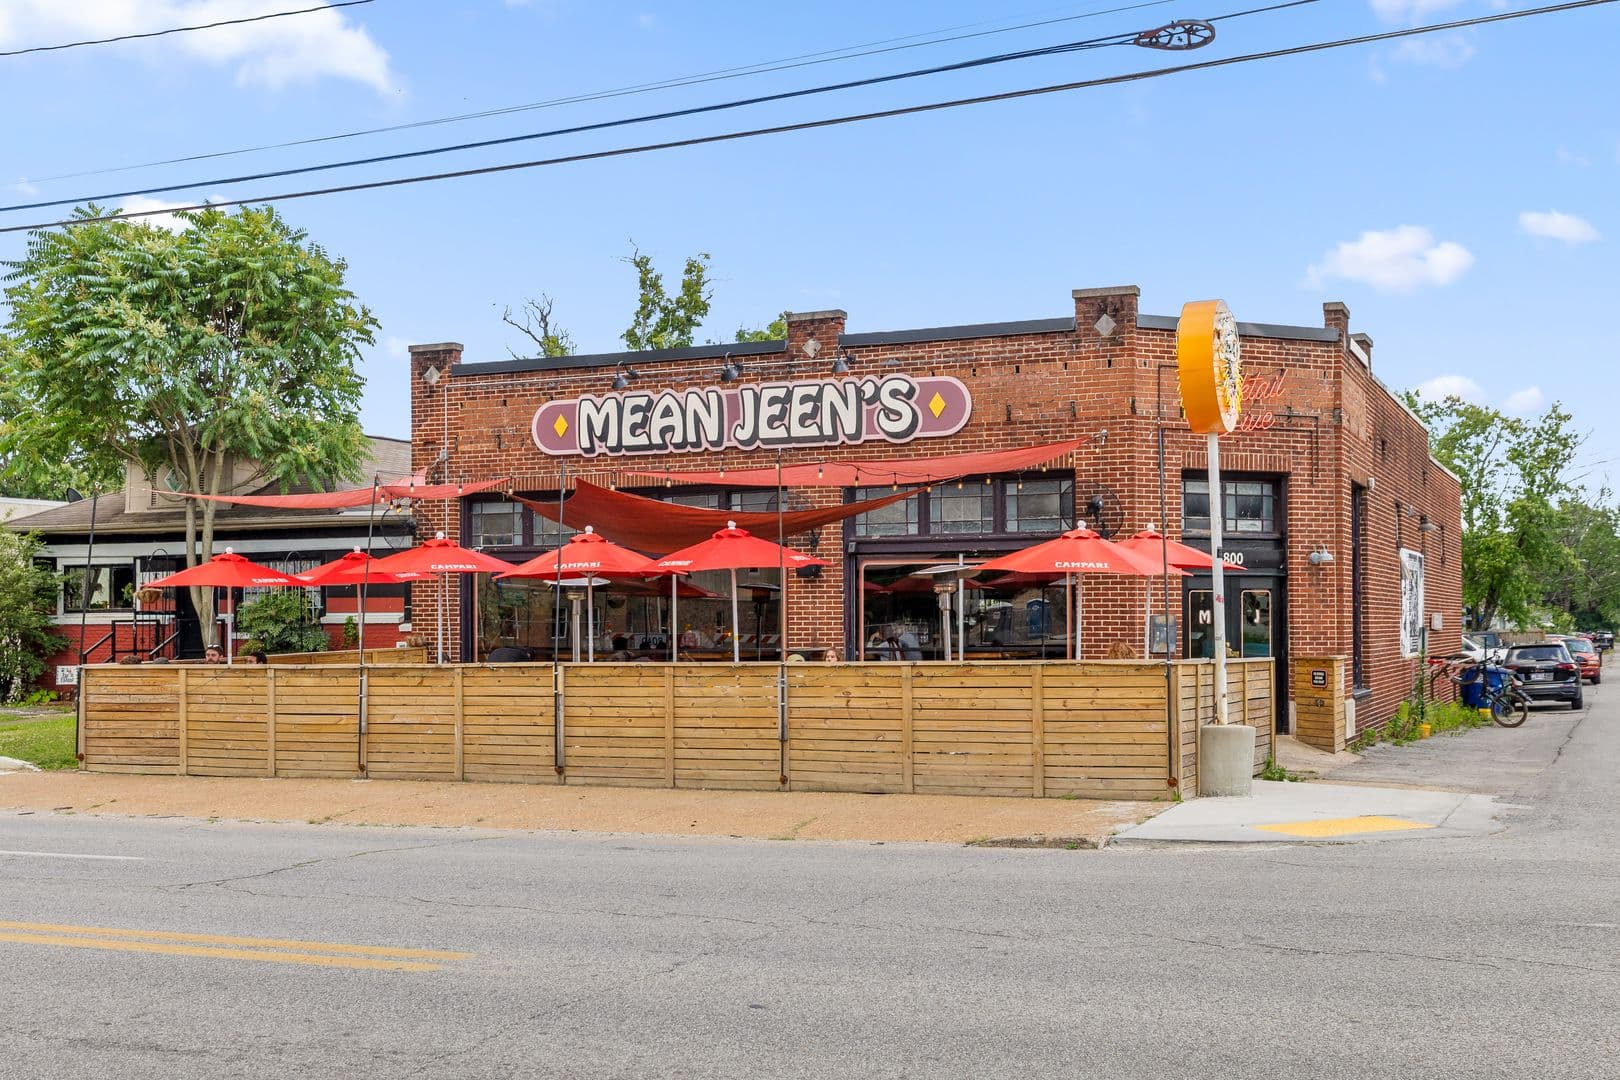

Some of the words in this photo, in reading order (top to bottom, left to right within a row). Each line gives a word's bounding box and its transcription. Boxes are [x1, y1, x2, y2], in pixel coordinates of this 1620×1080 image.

[579, 391, 726, 451] MEAN
[733, 377, 919, 446] JEEN'S
[1054, 561, 1109, 569] CAMPARI
[1223, 552, 1244, 565] 800
[1199, 609, 1212, 625] M
